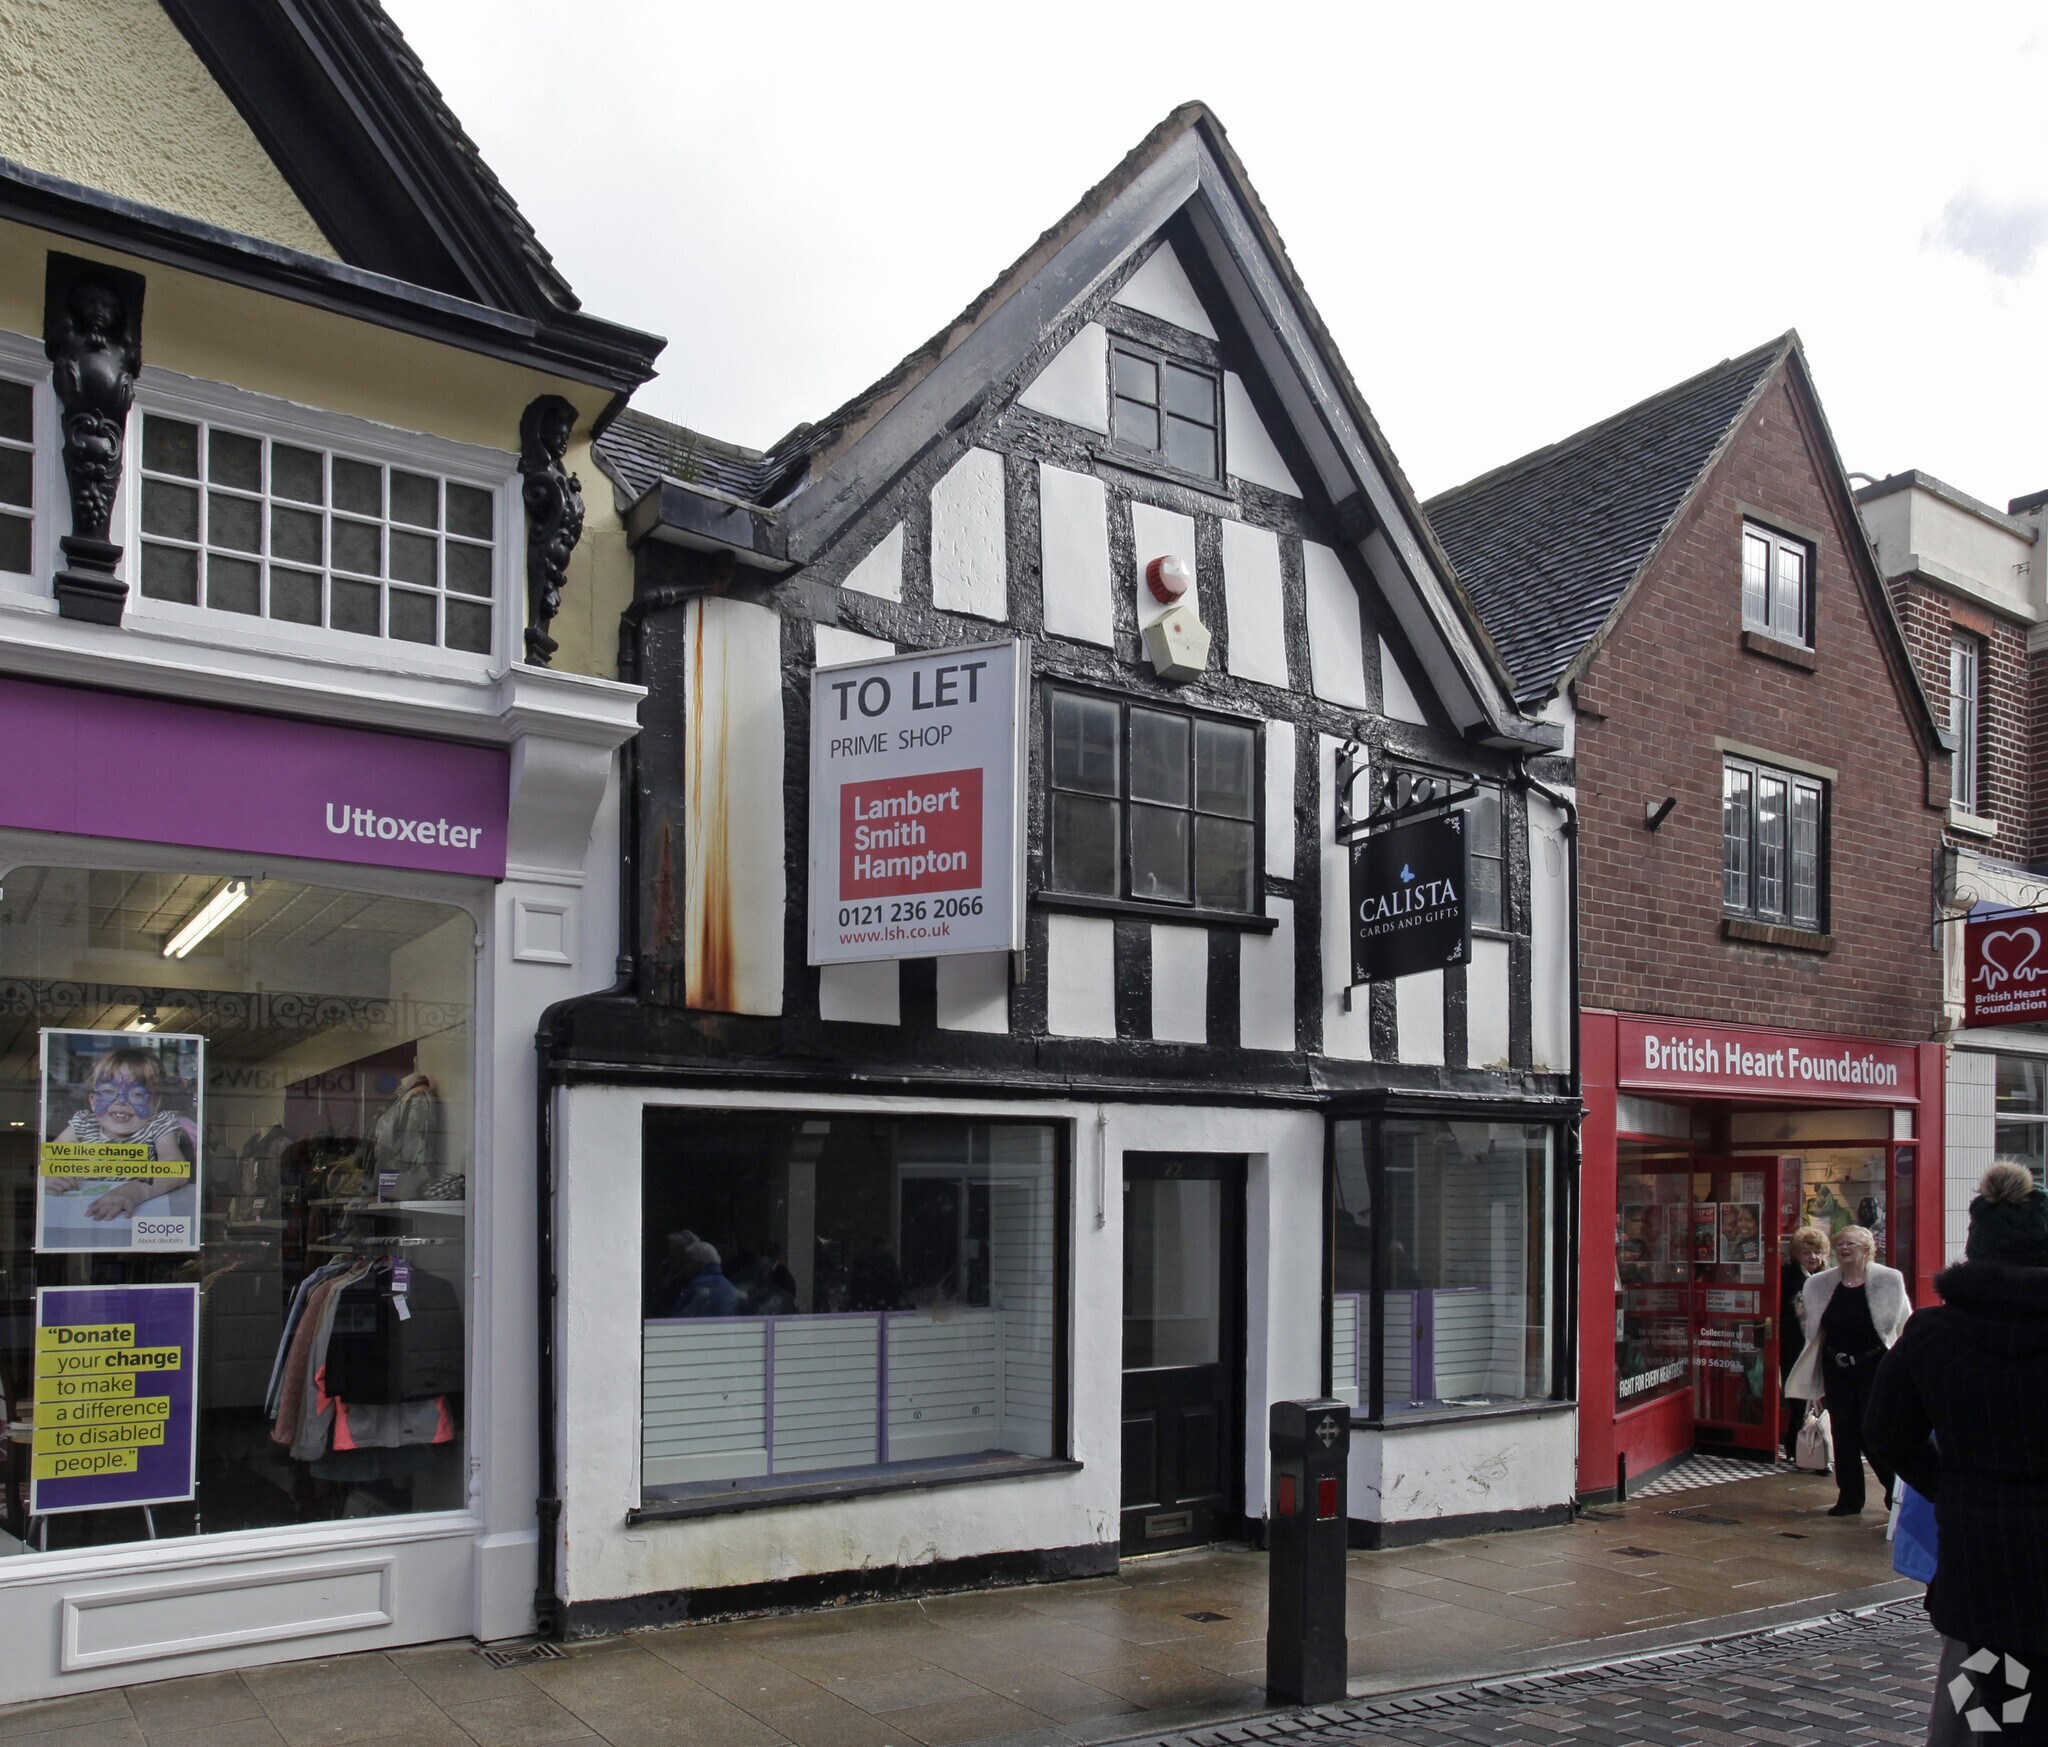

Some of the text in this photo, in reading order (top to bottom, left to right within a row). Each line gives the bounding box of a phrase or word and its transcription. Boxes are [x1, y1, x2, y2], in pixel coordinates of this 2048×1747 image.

[832, 661, 988, 721] TO LET
[830, 725, 953, 758] PRIME SHOP
[854, 786, 960, 821] Lambert
[325, 802, 482, 849] Uttoxeter
[854, 820, 926, 851] Smith
[853, 850, 967, 881] Hampton
[838, 895, 983, 927] 0121 236 2066
[1359, 878, 1458, 923] CALISTA
[839, 921, 951, 945] www.lsh.co.uk
[1360, 906, 1459, 938] CARDS AND GIFTS
[1975, 987, 2047, 1004] British Heart
[1975, 1000, 2047, 1015] Foundation
[1644, 1034, 1898, 1087] British Heart Foundation
[74, 1145, 96, 1156] like
[98, 1146, 144, 1159] change
[49, 1162, 90, 1175] (notes
[93, 1165, 113, 1173] are
[115, 1163, 148, 1175] good
[137, 1221, 185, 1236] Scope
[1698, 1336, 1731, 1347] unwanted
[1700, 1327, 1735, 1338] Collection
[57, 1351, 179, 1374] your change
[57, 1376, 133, 1395] to make
[1619, 1377, 1634, 1398] FIGHT
[1635, 1373, 1645, 1393] FOR
[1645, 1368, 1660, 1389] EVERY
[1660, 1361, 1684, 1385] HEARTBEAT
[56, 1401, 168, 1421] a difference
[56, 1423, 162, 1446] to disabled
